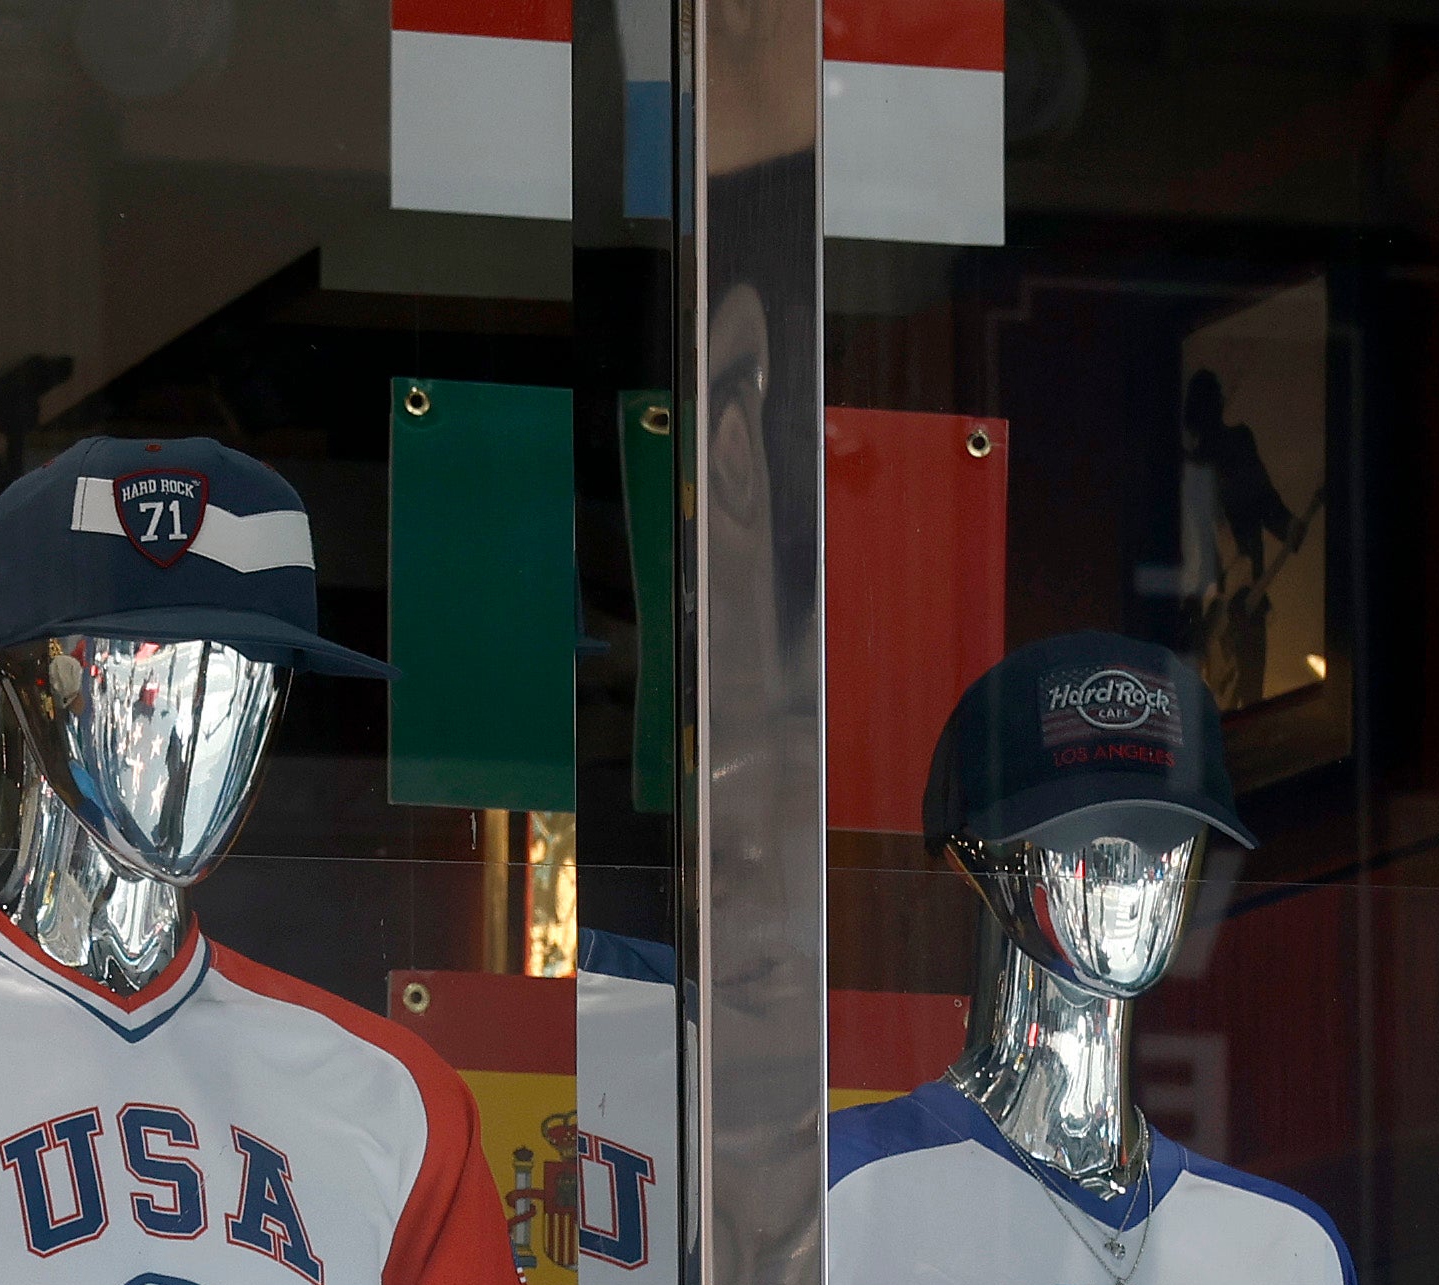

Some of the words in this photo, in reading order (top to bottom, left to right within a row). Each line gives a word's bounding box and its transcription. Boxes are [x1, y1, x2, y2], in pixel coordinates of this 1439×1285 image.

[122, 479, 157, 502] HARD
[160, 479, 195, 499] ROCK
[138, 500, 189, 543] 71
[1049, 680, 1115, 711] Hard
[1116, 682, 1170, 716] Rock
[1053, 747, 1089, 767] LOS
[1094, 744, 1175, 767] ANGELES
